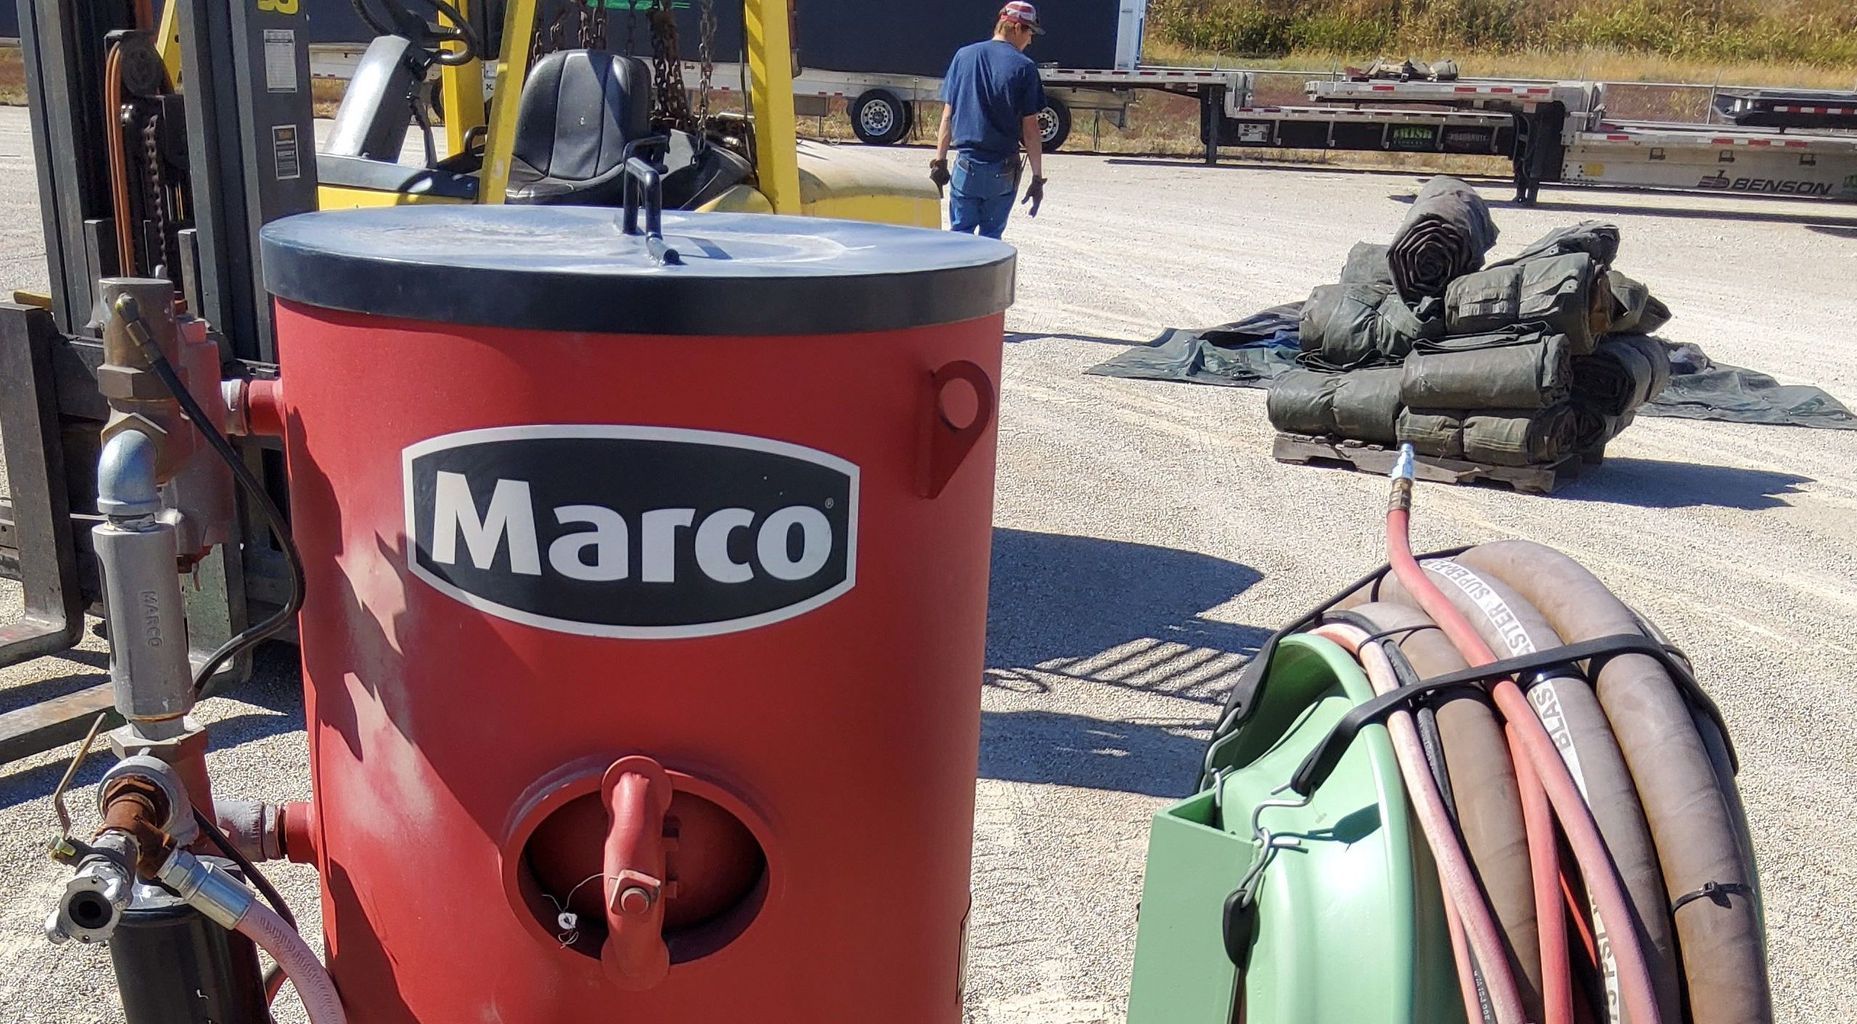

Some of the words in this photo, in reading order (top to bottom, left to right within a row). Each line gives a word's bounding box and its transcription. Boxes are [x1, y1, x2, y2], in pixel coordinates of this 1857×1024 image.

[1731, 178, 1834, 195] BENSON
[432, 470, 833, 584] Marco
[141, 590, 162, 647] MARCO
